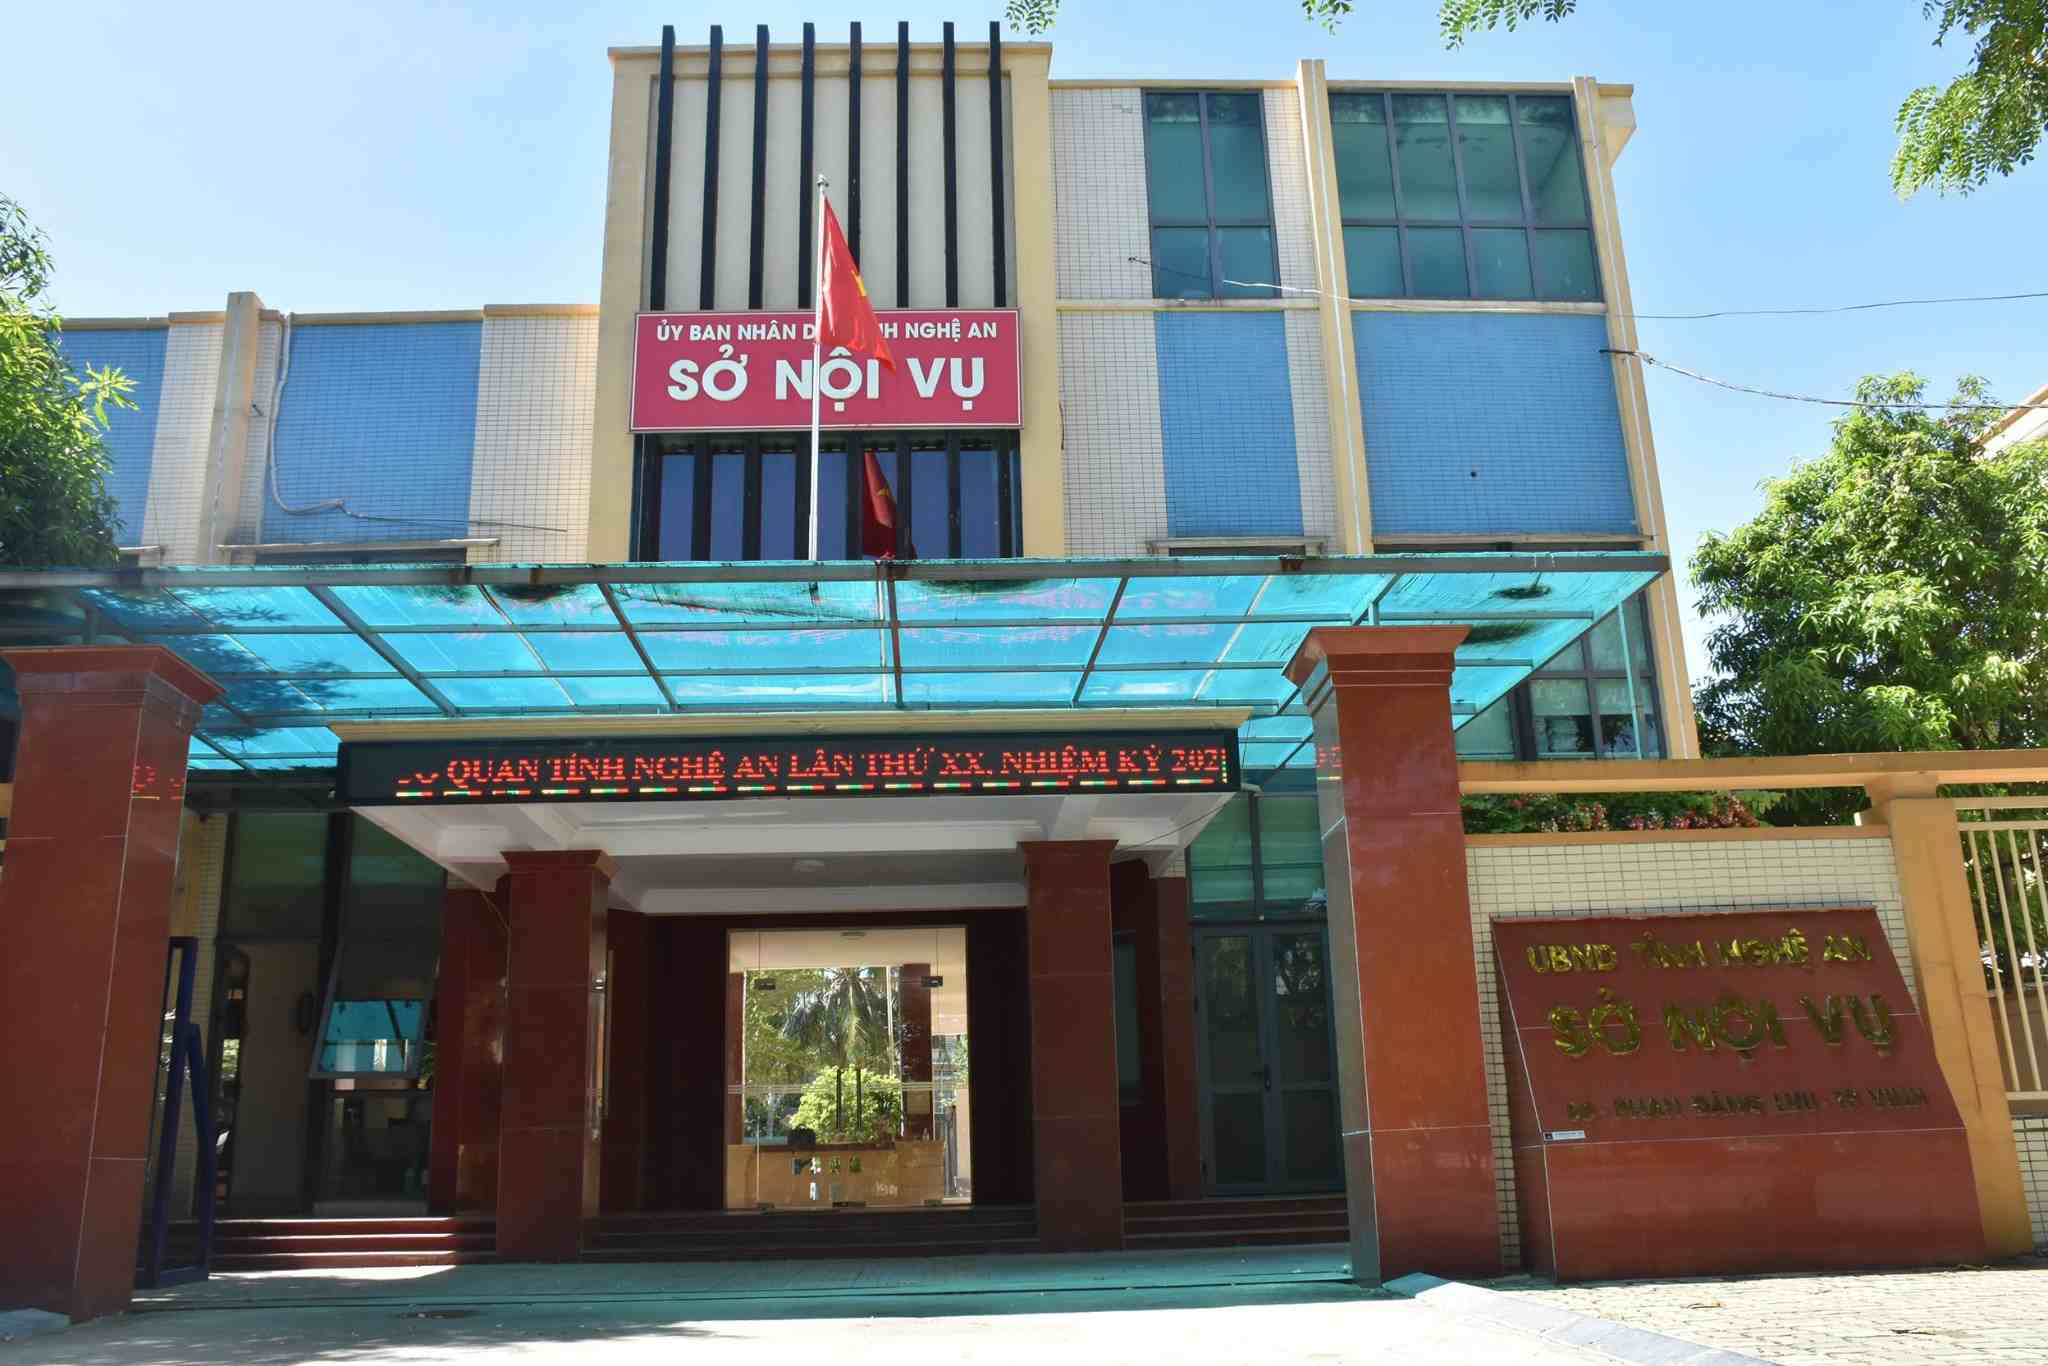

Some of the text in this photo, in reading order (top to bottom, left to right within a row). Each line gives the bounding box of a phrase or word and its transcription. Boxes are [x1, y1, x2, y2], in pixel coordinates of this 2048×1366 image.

[656, 319, 684, 341] ỦY
[689, 324, 731, 341] BAN
[737, 320, 796, 341] NHÂN
[905, 318, 961, 342] NGHỆ
[967, 322, 997, 338] AN
[667, 344, 985, 411] SỞ NỘI VỤ
[447, 759, 539, 788] QUAN
[632, 751, 725, 784] NGHỆ
[733, 755, 779, 777] AN
[1000, 745, 1110, 779] NHIỆM
[1527, 944, 1617, 972] UBND
